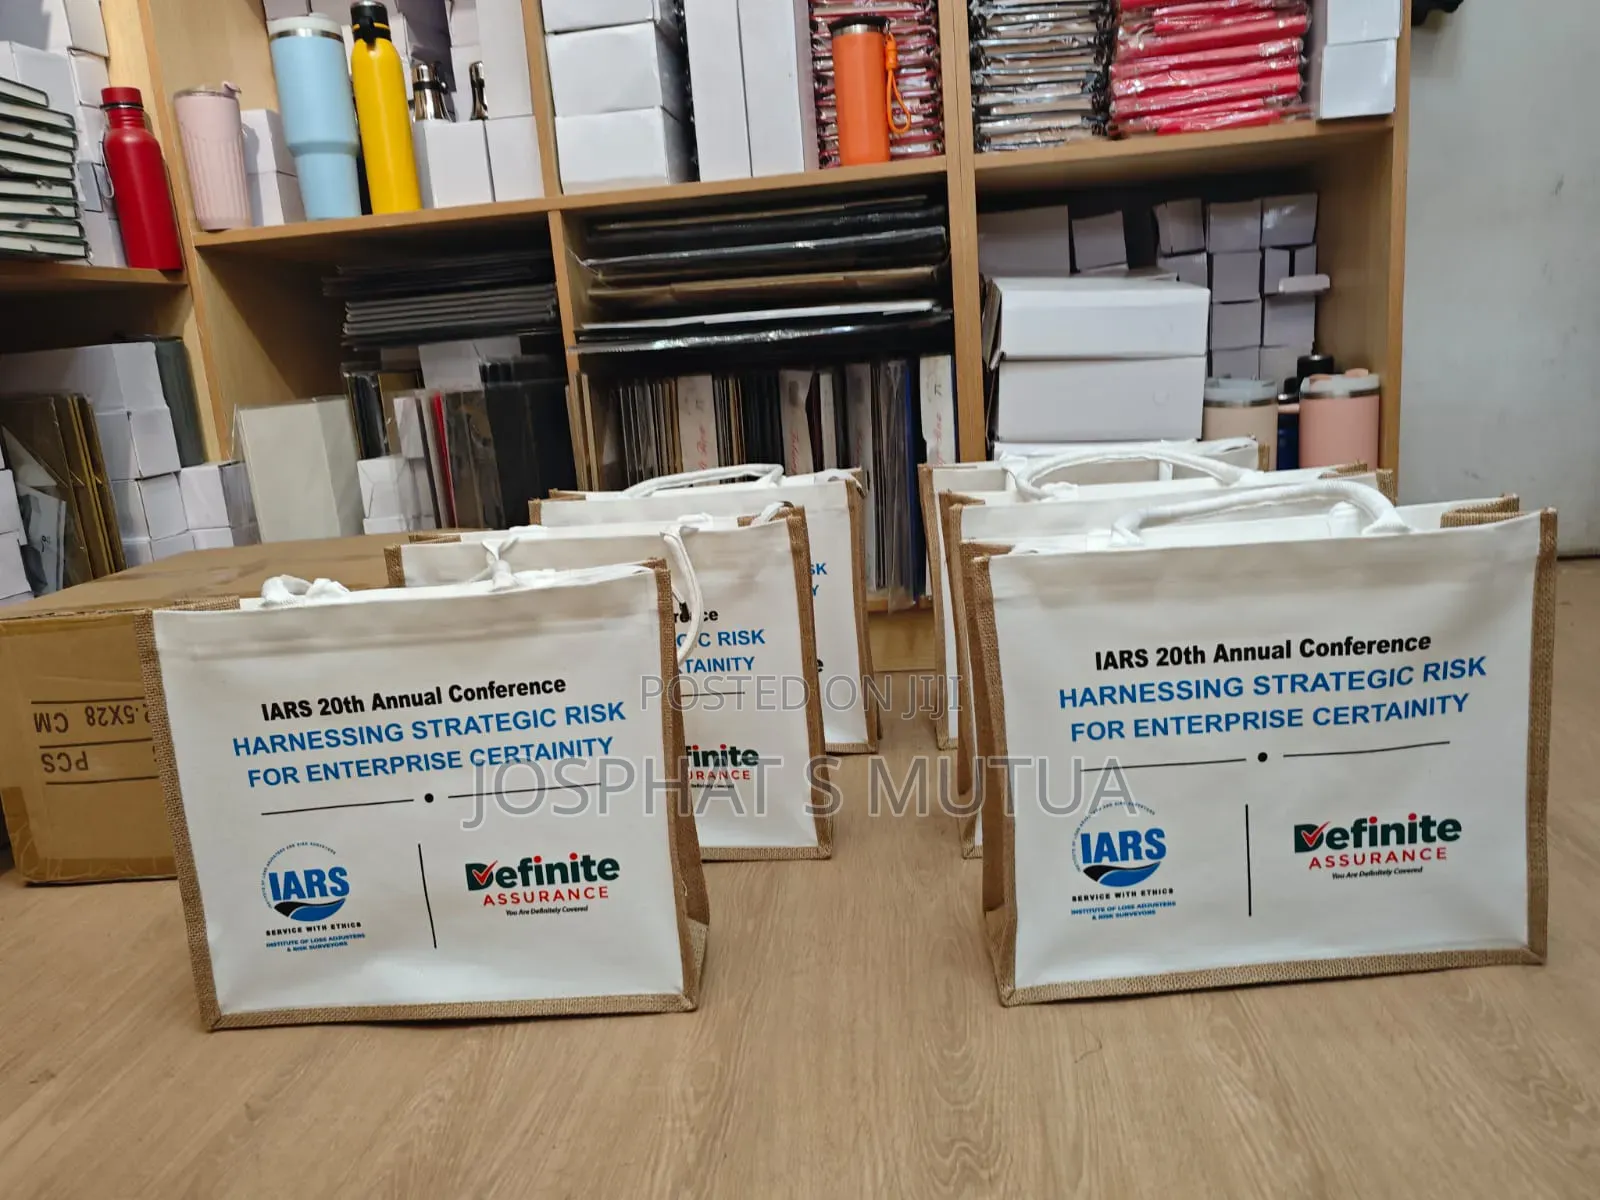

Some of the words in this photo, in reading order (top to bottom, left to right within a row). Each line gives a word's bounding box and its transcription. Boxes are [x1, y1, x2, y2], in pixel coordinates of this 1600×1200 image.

[717, 629, 765, 647] RISK
[1095, 649, 1149, 671] IARS
[1155, 645, 1206, 667] 20th
[1213, 640, 1292, 663] Annual
[1299, 635, 1432, 658] Conference
[679, 656, 755, 674] TAINITY
[1059, 677, 1244, 709] HARNESSING
[1253, 666, 1414, 696] STRATEGIC
[1423, 655, 1487, 683] RISK
[261, 700, 312, 721] IARS
[318, 694, 365, 716] 20th
[372, 686, 442, 711] Annual
[448, 678, 566, 703] Conference
[33, 712, 69, 733] CM
[232, 723, 404, 757] HARNESSING
[411, 707, 557, 740] STRATEGIC
[565, 701, 626, 726] RISK
[1071, 720, 1126, 742] FOR
[1134, 708, 1304, 738] ENTERPRISE
[1312, 693, 1470, 726] CERTAINITY
[41, 751, 88, 773] PCS
[248, 766, 300, 788] FOR
[306, 750, 463, 782] ENTERPRISE
[469, 736, 613, 767] CERTAINITY
[1294, 812, 1462, 853] Definite
[1080, 827, 1166, 864] IARS
[1308, 847, 1447, 870] ASSURANCE
[465, 852, 620, 891] Definite
[1332, 872, 1345, 880] You
[1345, 870, 1358, 879] Are
[1359, 869, 1392, 878] Definitely
[1393, 866, 1423, 875] Covered
[268, 866, 350, 901] IARS
[1071, 892, 1111, 902] SERVICE
[1114, 890, 1137, 899] WITH
[1140, 887, 1174, 896] ETHICS
[483, 886, 609, 906] ASSURANCE
[1117, 903, 1136, 911] LOSS
[505, 909, 518, 917] You
[518, 908, 530, 916] Are
[530, 906, 561, 915] Definitely
[561, 905, 588, 913] Covered
[265, 925, 303, 936] SERVICE
[305, 923, 328, 933] WITH
[330, 921, 362, 930] ETHICS
